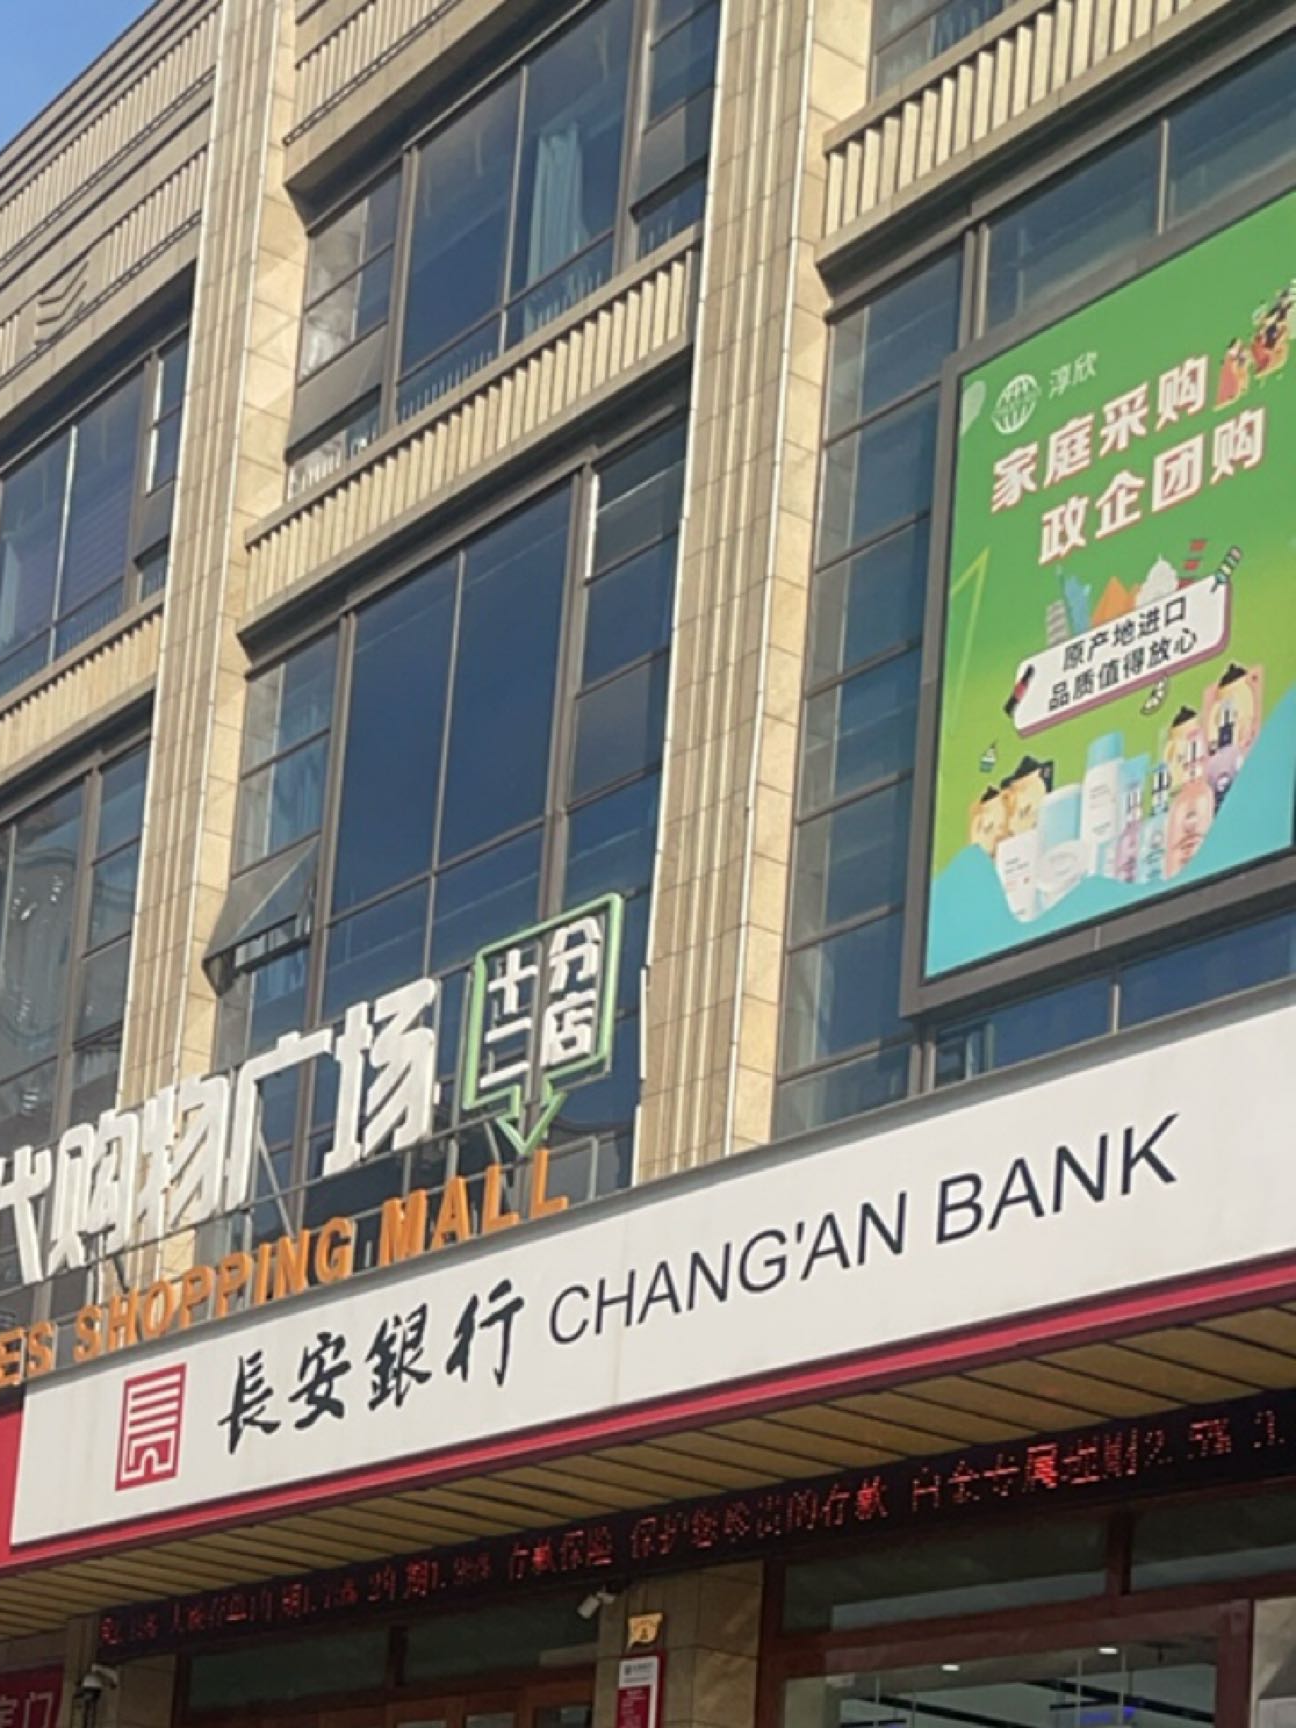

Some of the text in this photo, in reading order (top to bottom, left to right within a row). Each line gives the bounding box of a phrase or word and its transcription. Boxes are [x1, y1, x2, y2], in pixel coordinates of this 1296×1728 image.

[991, 354, 1210, 513] 家庭采购
[1038, 407, 1266, 566] 政企团购
[1049, 627, 1198, 710] 品质值得放心
[1063, 597, 1187, 671] 原产地进口
[479, 947, 537, 1089] 十二
[540, 915, 602, 1067] 分店
[72, 1217, 354, 1358] SHOPPING
[379, 1148, 570, 1262] MALL
[547, 1112, 1181, 1346] CHANG'AN BANK
[217, 1279, 525, 1456] 長安銀行
